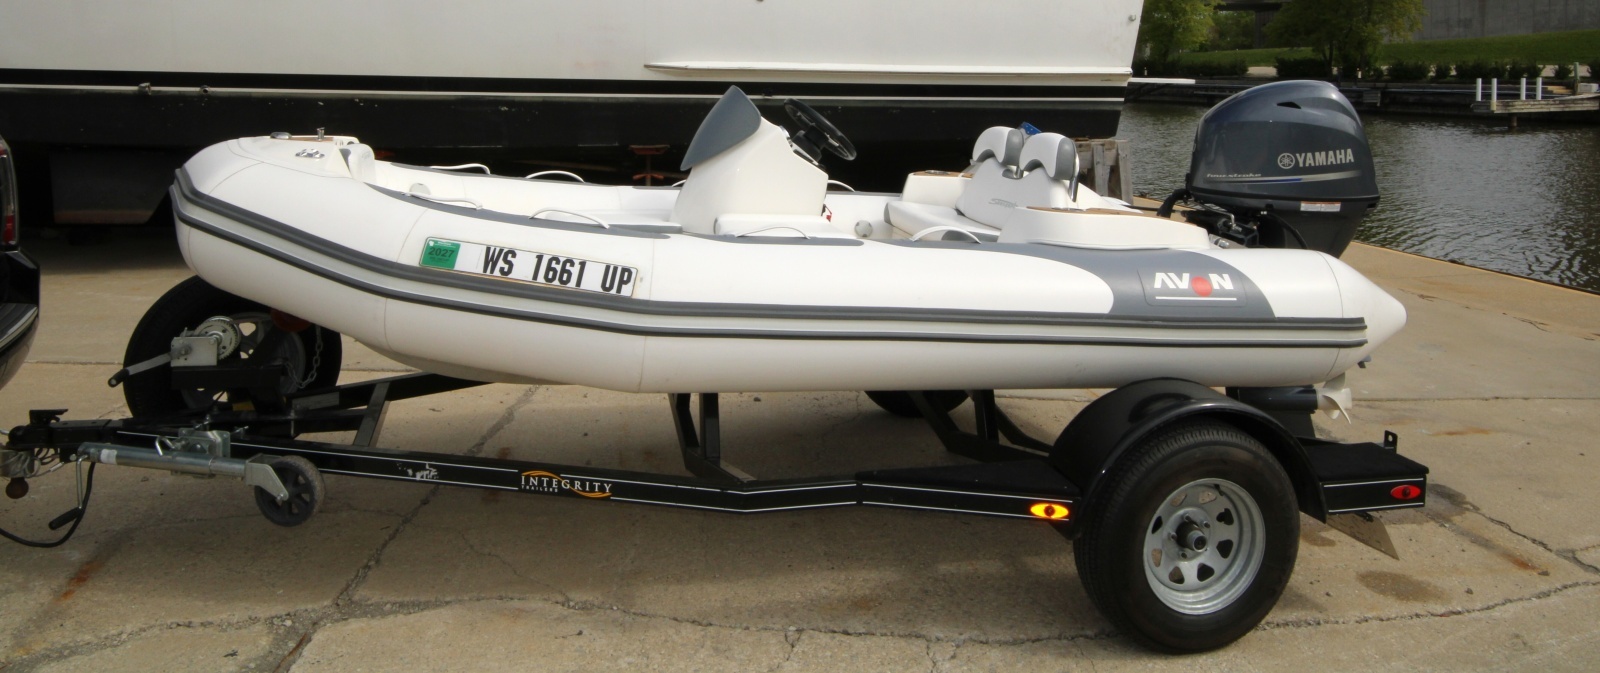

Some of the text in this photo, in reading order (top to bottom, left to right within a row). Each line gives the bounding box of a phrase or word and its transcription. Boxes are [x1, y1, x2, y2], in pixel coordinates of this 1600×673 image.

[1295, 148, 1354, 167] YAMAHA
[428, 247, 455, 258] 2027
[482, 246, 633, 294] WS 1661 UP
[521, 475, 612, 492] INTEGRITY
